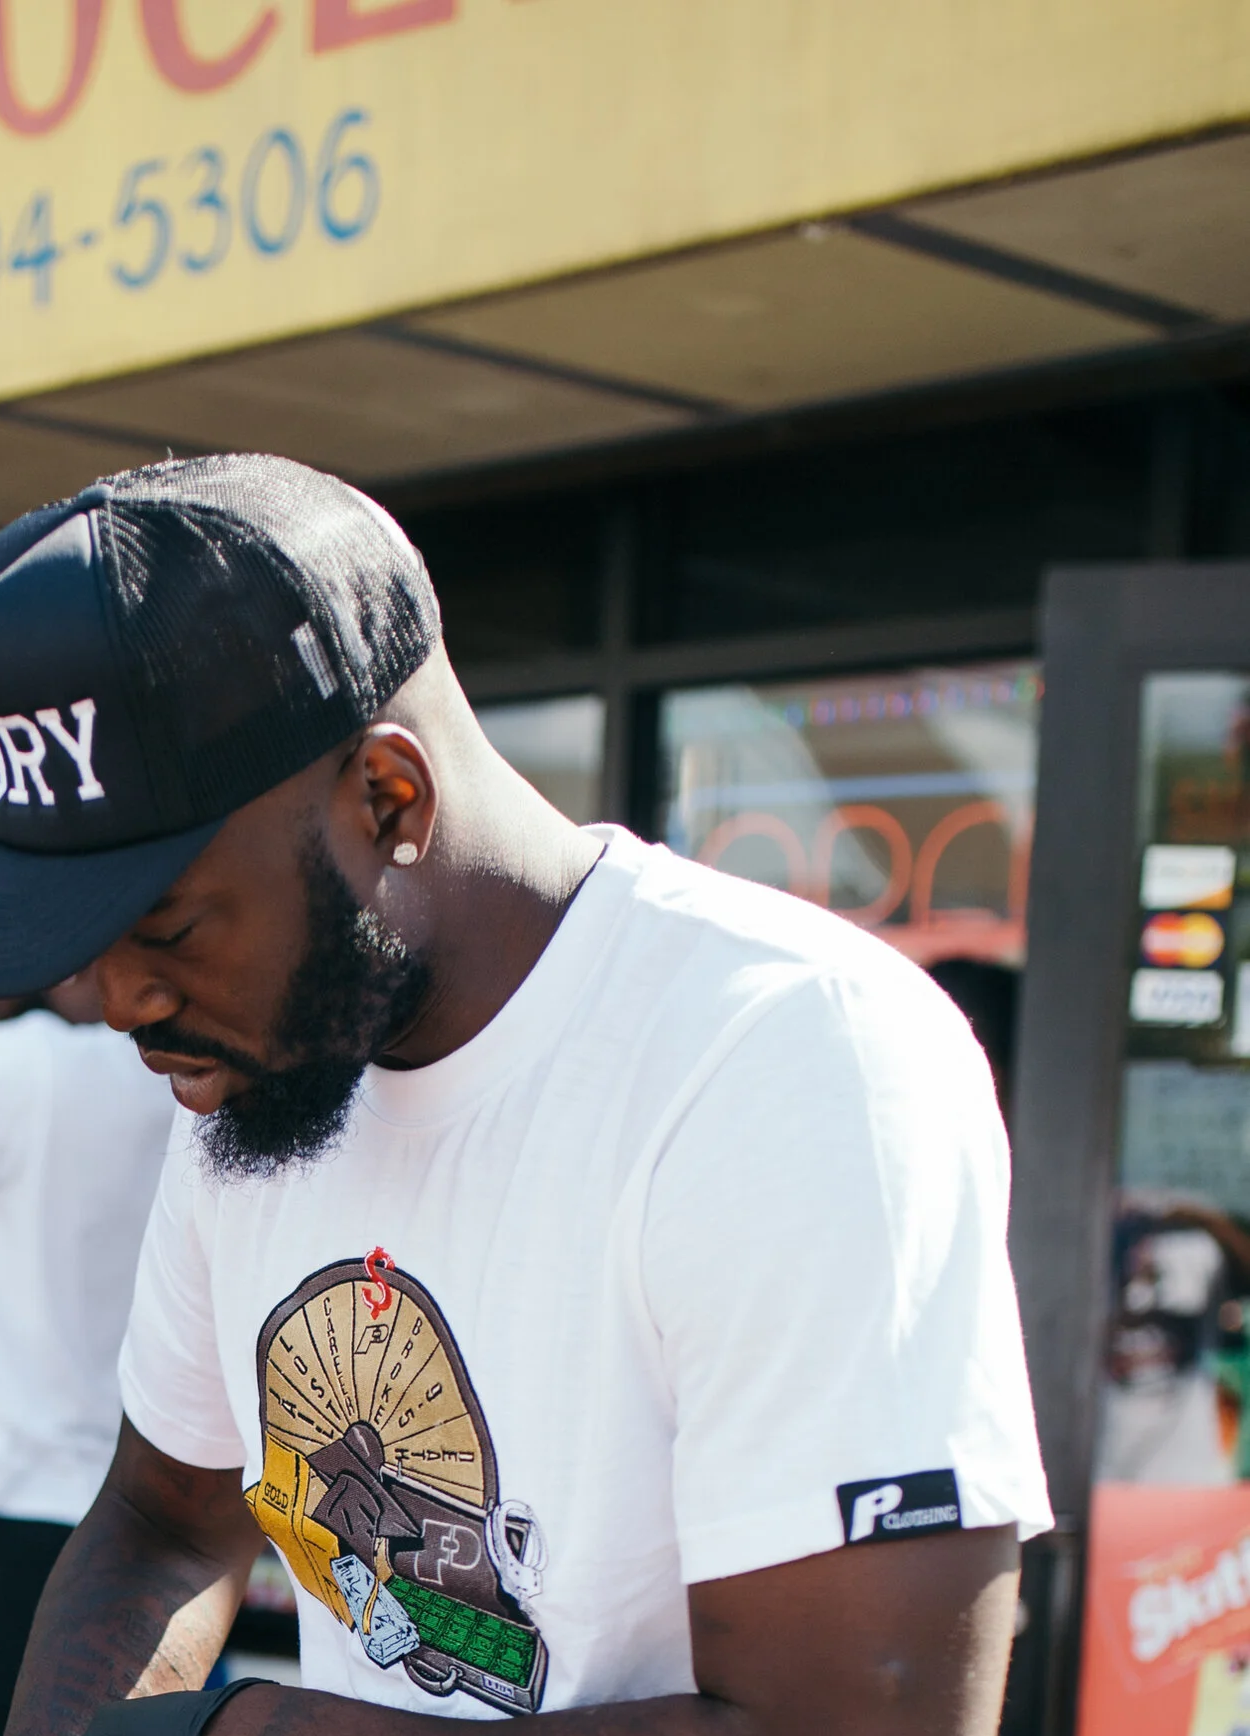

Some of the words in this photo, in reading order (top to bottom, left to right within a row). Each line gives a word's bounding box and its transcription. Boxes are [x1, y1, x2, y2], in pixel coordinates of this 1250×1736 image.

[279, 1335, 341, 1420] LOST
[374, 1316, 422, 1425] BROKE
[264, 1481, 289, 1509] GOLD
[882, 1504, 958, 1529] CLOTHING
